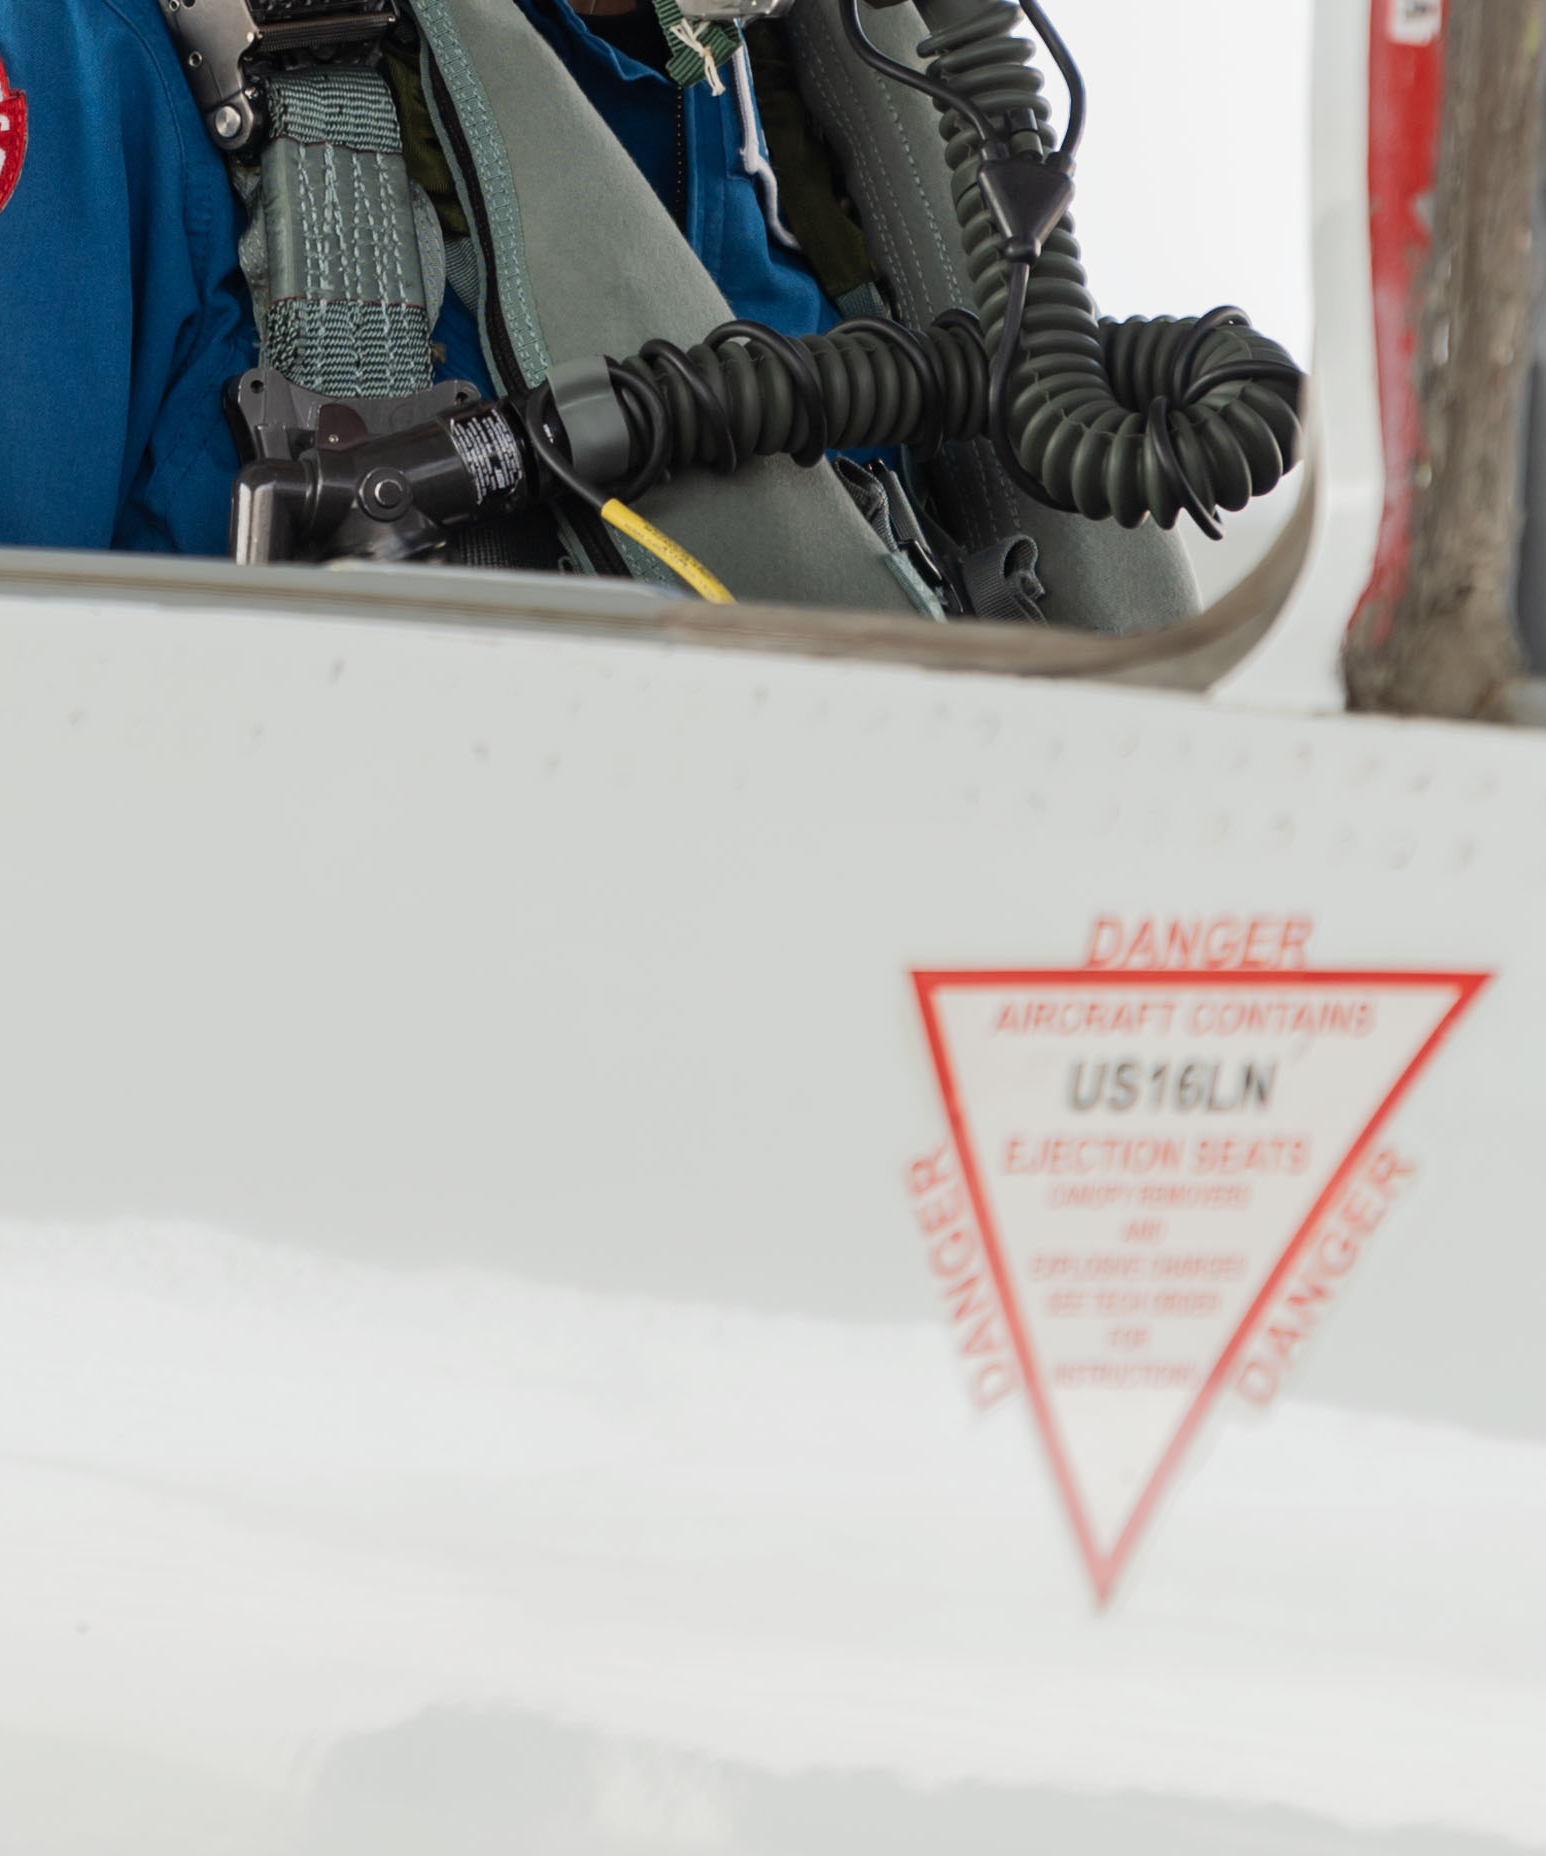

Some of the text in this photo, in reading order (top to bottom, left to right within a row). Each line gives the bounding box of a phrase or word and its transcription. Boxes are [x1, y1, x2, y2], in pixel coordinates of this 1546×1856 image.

[1082, 915, 1315, 971] DANGER
[991, 1000, 1379, 1038] AIRCRAFT CONTAINS
[1067, 1059, 1279, 1113] US16LN
[1003, 1135, 1313, 1177] EJECTION SEATS
[908, 1141, 1019, 1413] DANGER
[1236, 1146, 1416, 1410] DANGER
